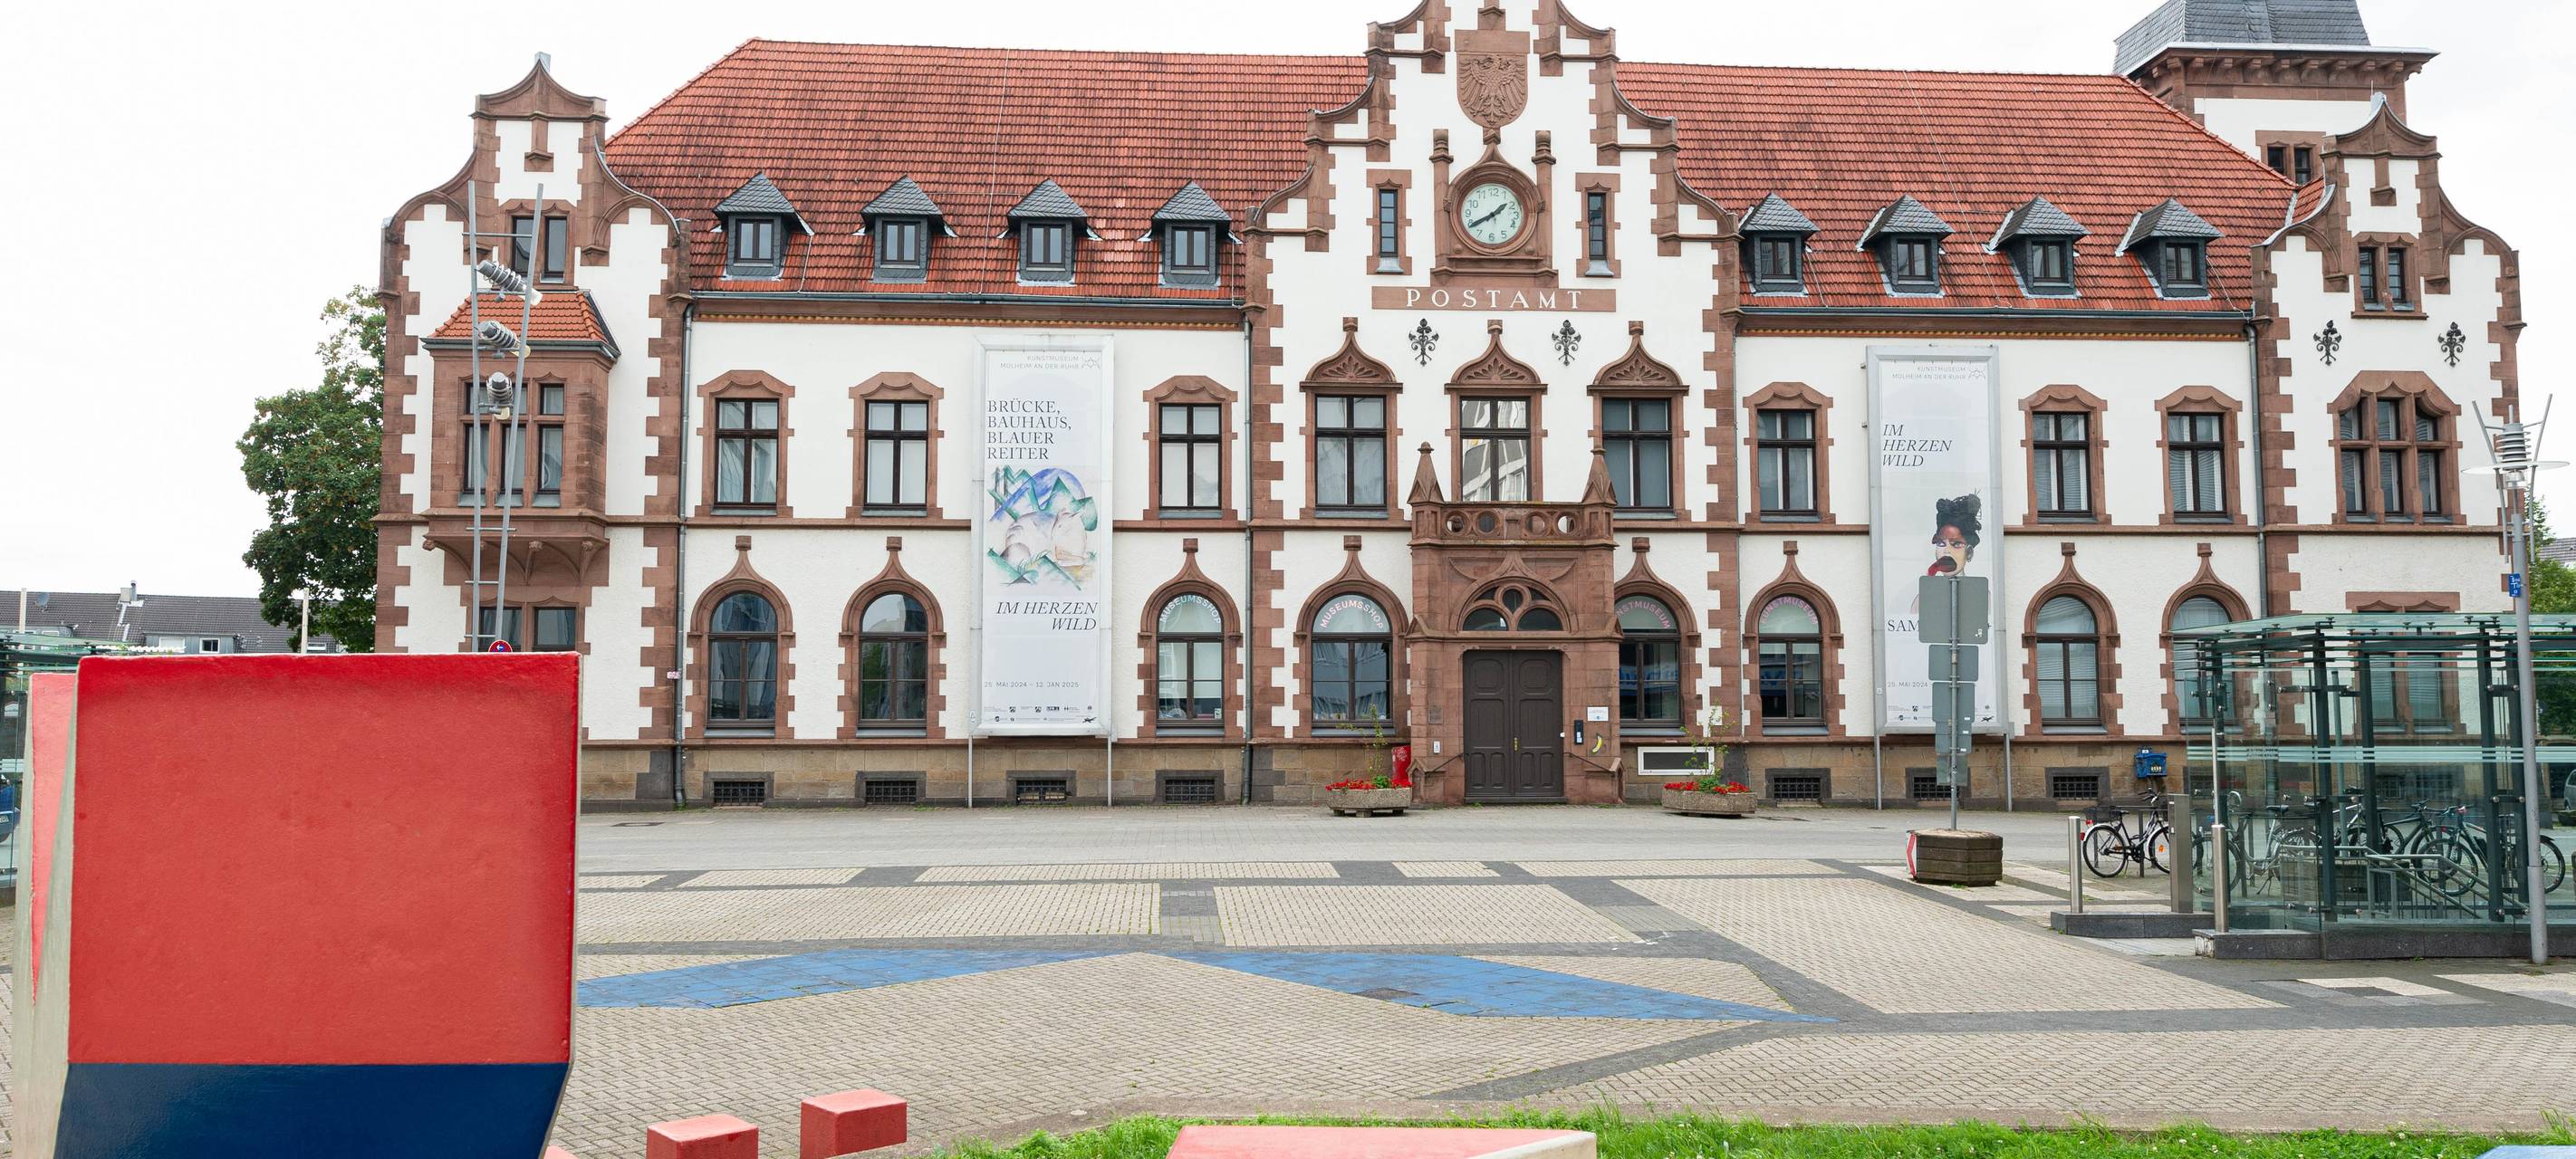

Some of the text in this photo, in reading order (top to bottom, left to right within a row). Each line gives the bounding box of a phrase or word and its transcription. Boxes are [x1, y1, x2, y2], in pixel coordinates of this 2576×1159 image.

[1476, 190, 1485, 198] 11
[1488, 187, 1499, 196] 12
[1467, 200, 1478, 208] 10
[1508, 201, 1515, 209] 2
[1465, 209, 1471, 217] 9
[1514, 211, 1519, 220] 3
[1510, 220, 1516, 229] 4
[1476, 229, 1483, 237] 7
[1488, 233, 1495, 242] 6
[1501, 231, 1507, 239] 5
[1406, 288, 1581, 309] POSTAMT
[987, 398, 1061, 415] BRÜCKE,
[987, 416, 1072, 431] BAUHAUS,
[1882, 424, 1904, 436] IM
[987, 432, 1055, 444] BLAUER
[1883, 439, 1952, 452] HERZEN
[987, 447, 1049, 459] REITER
[1882, 455, 1924, 466] WILD
[996, 601, 1099, 614] IM HERZEN
[1159, 595, 1221, 624] MUSEUMSSHOP
[1320, 599, 1383, 628] MUSEUMSSHOP
[1615, 600, 1671, 629] NSTMUSEUM
[1052, 618, 1097, 630] WILD
